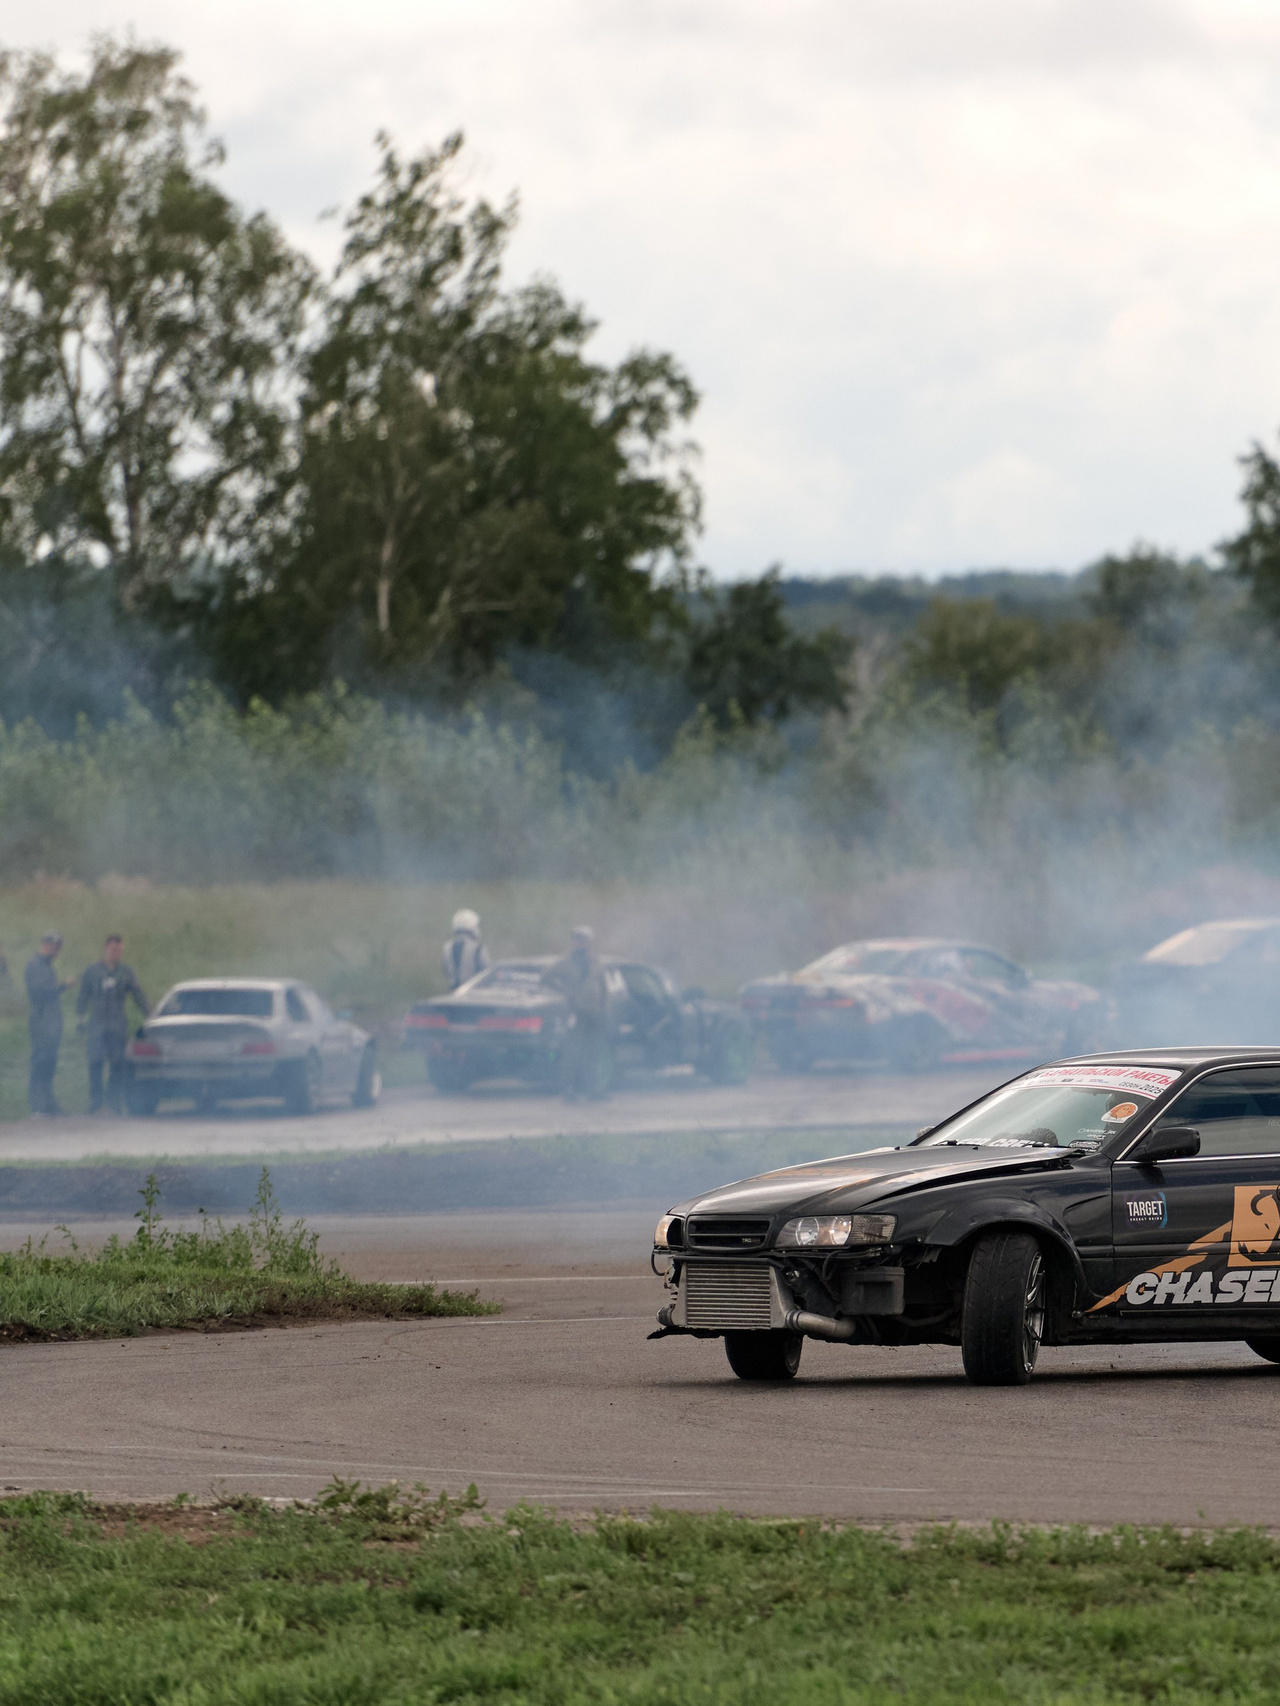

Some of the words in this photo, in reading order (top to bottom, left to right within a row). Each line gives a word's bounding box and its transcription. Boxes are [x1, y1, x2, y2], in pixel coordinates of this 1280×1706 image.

[1124, 1069, 1176, 1086] РАКЕТЫ
[1138, 1083, 1164, 1094] 2025
[1126, 1200, 1163, 1216] TARGET
